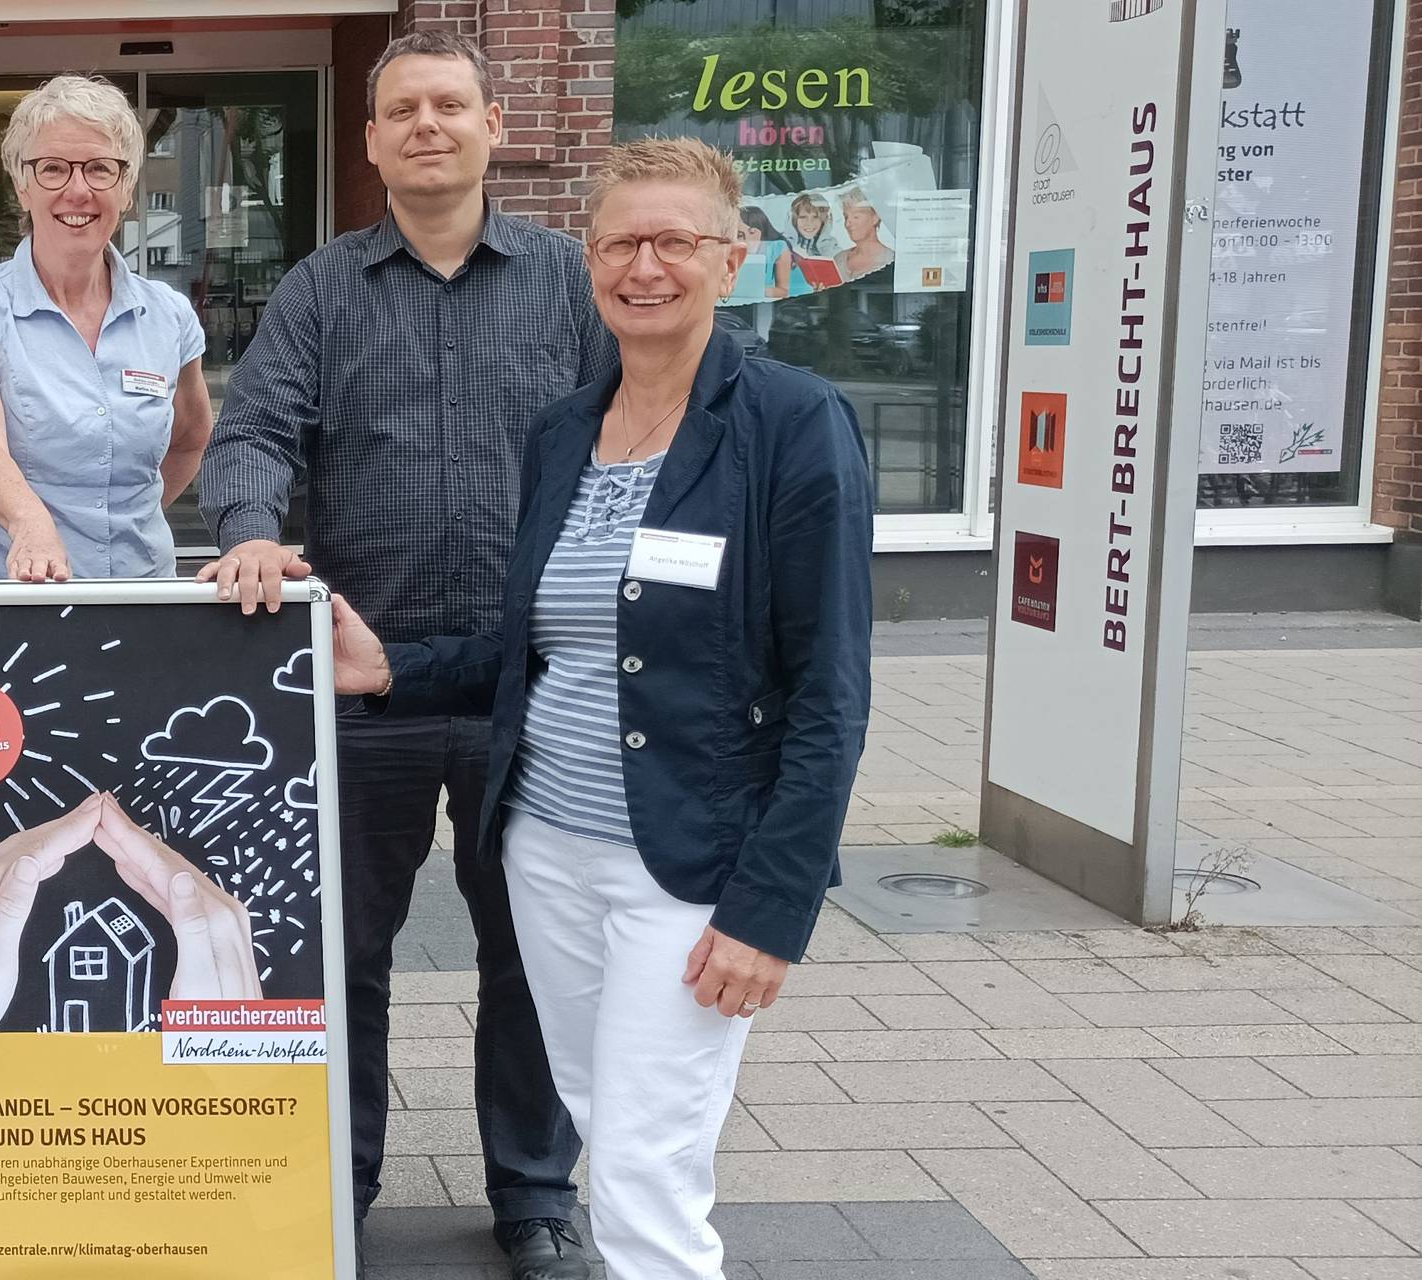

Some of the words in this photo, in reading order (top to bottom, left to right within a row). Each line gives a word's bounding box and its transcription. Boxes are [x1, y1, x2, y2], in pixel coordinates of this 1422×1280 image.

[692, 54, 874, 112] lesen
[1221, 101, 1305, 130] kstatt
[739, 117, 824, 146] hören
[1242, 145, 1274, 157] von
[732, 156, 831, 173] staunen
[1218, 168, 1253, 181] ster
[1241, 235, 1278, 247] 10:00
[1296, 234, 1332, 246] 13:00
[1242, 271, 1286, 284] Jahren
[1214, 357, 1235, 370] via
[1240, 356, 1271, 369] Mail
[1277, 356, 1294, 368] ist
[1300, 355, 1321, 368] bis
[1103, 101, 1157, 653] BERT-BRECHT-HAUS
[1203, 398, 1282, 411] hausen.de
[166, 1005, 326, 1025] verbraucherzentral
[78, 1098, 147, 1116] SCHON
[152, 1098, 297, 1116] VORGESORGT?
[40, 1127, 86, 1146] UMS
[92, 1127, 146, 1145] HAUS
[23, 1156, 100, 1170] unabhängige
[103, 1156, 187, 1168] Oberhausener
[190, 1156, 261, 1169] Expertinnen
[265, 1156, 288, 1168] und
[62, 1173, 127, 1185] Bauwesen,
[131, 1172, 175, 1186] Energie
[178, 1172, 201, 1184] und
[205, 1172, 248, 1184] Umwelt
[252, 1172, 272, 1184] wie
[60, 1189, 104, 1203] geplant
[108, 1189, 131, 1200] und
[134, 1189, 186, 1203] gestaltet
[189, 1189, 236, 1200] werden.
